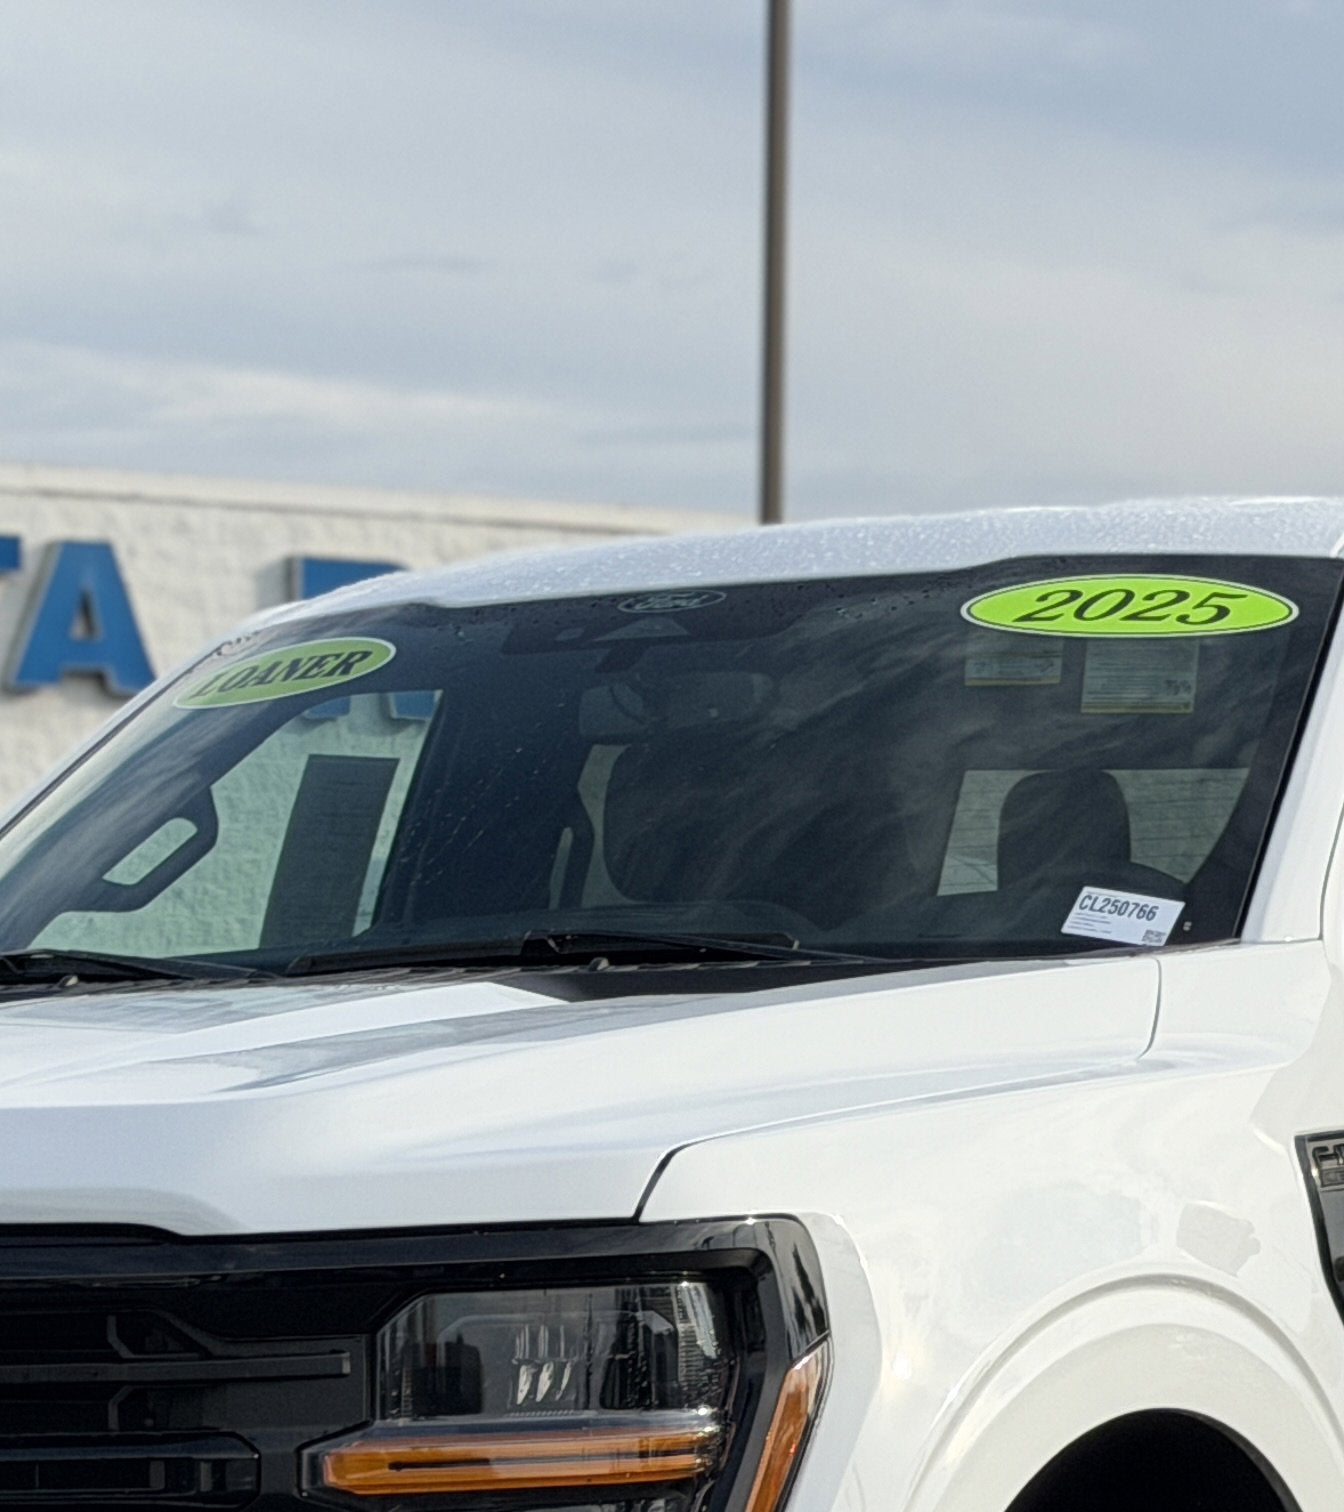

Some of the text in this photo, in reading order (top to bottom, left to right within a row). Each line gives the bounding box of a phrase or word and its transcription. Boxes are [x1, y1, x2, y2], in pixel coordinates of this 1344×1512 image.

[1012, 588, 1250, 626] 2025
[189, 651, 373, 698] LOANER
[1079, 894, 1160, 921] CL250766
